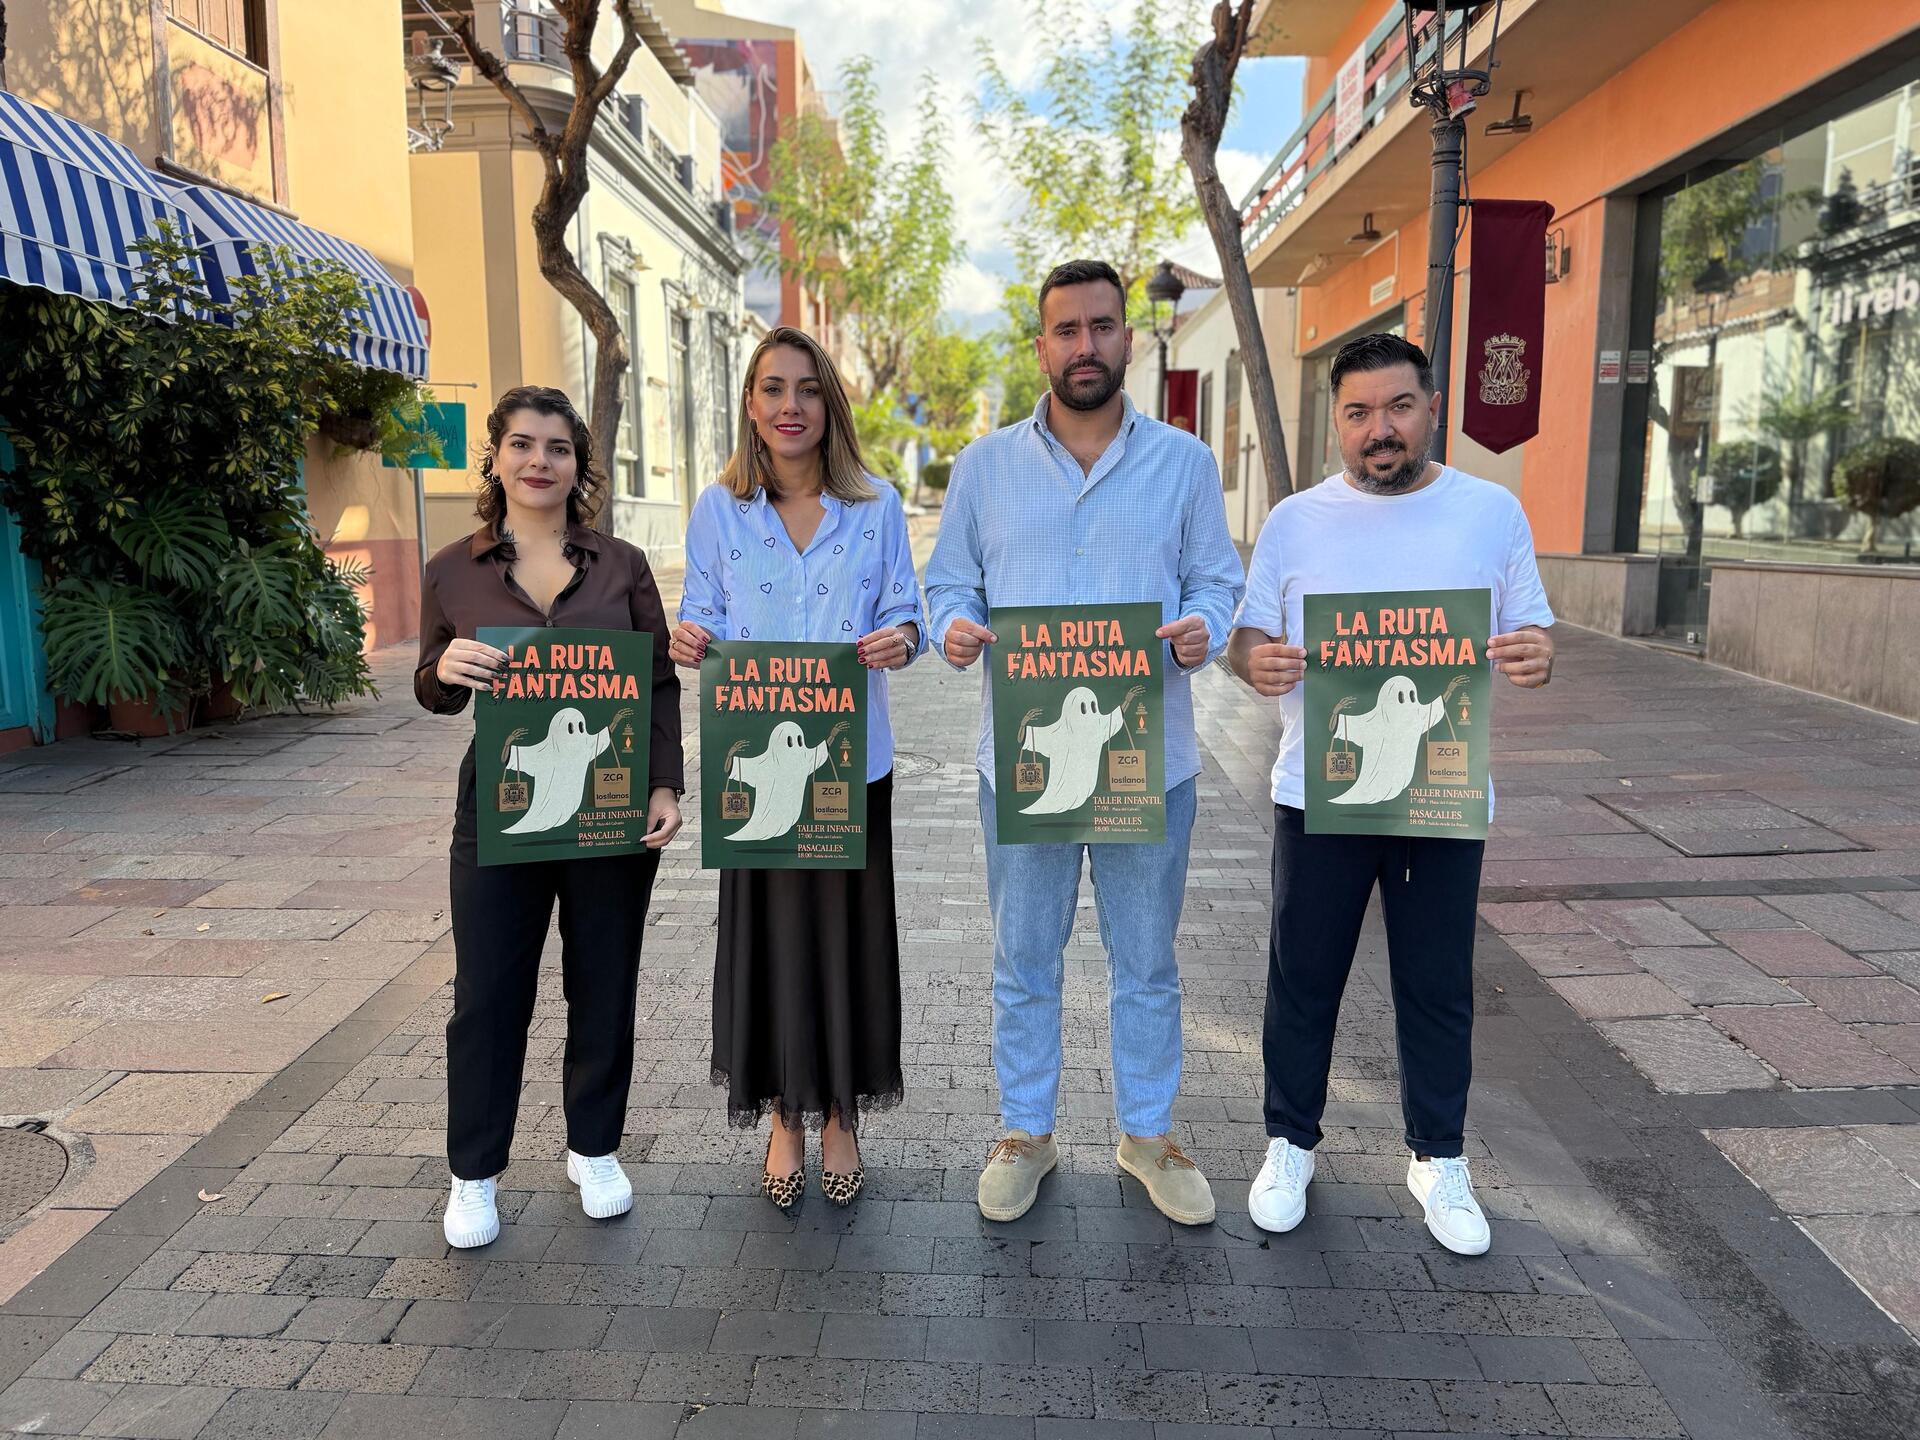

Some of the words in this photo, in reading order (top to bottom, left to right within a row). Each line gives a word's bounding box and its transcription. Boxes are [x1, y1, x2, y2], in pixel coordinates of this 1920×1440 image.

[1336, 611, 1369, 636] LA
[1379, 607, 1448, 636] RUTA
[1021, 623, 1052, 648] LA
[1061, 619, 1125, 648] RUTA
[508, 644, 541, 669] LA
[550, 644, 615, 670] RUTA
[1320, 638, 1477, 667] FANTASMA
[1007, 650, 1151, 679] FANTASMA
[729, 658, 760, 682] LA
[769, 657, 831, 684] RUTA
[492, 673, 640, 700] FANTASMA
[715, 685, 856, 713] FANTASMA
[1436, 747, 1460, 757] ZCA
[1117, 756, 1139, 765] ZCA
[603, 773, 624, 782] ZCA
[822, 787, 842, 796] ZCA
[1409, 788, 1440, 797] TALLER
[1444, 789, 1484, 799] INFANTIL
[578, 812, 606, 820] TALLER
[608, 810, 644, 819] INFANTIL
[1410, 810, 1462, 820] PASACALLES
[1094, 817, 1142, 825] PASACALLES
[827, 825, 863, 833] INFANTIL
[578, 830, 625, 840] PASACALLES
[798, 844, 843, 852] PASACALLES
